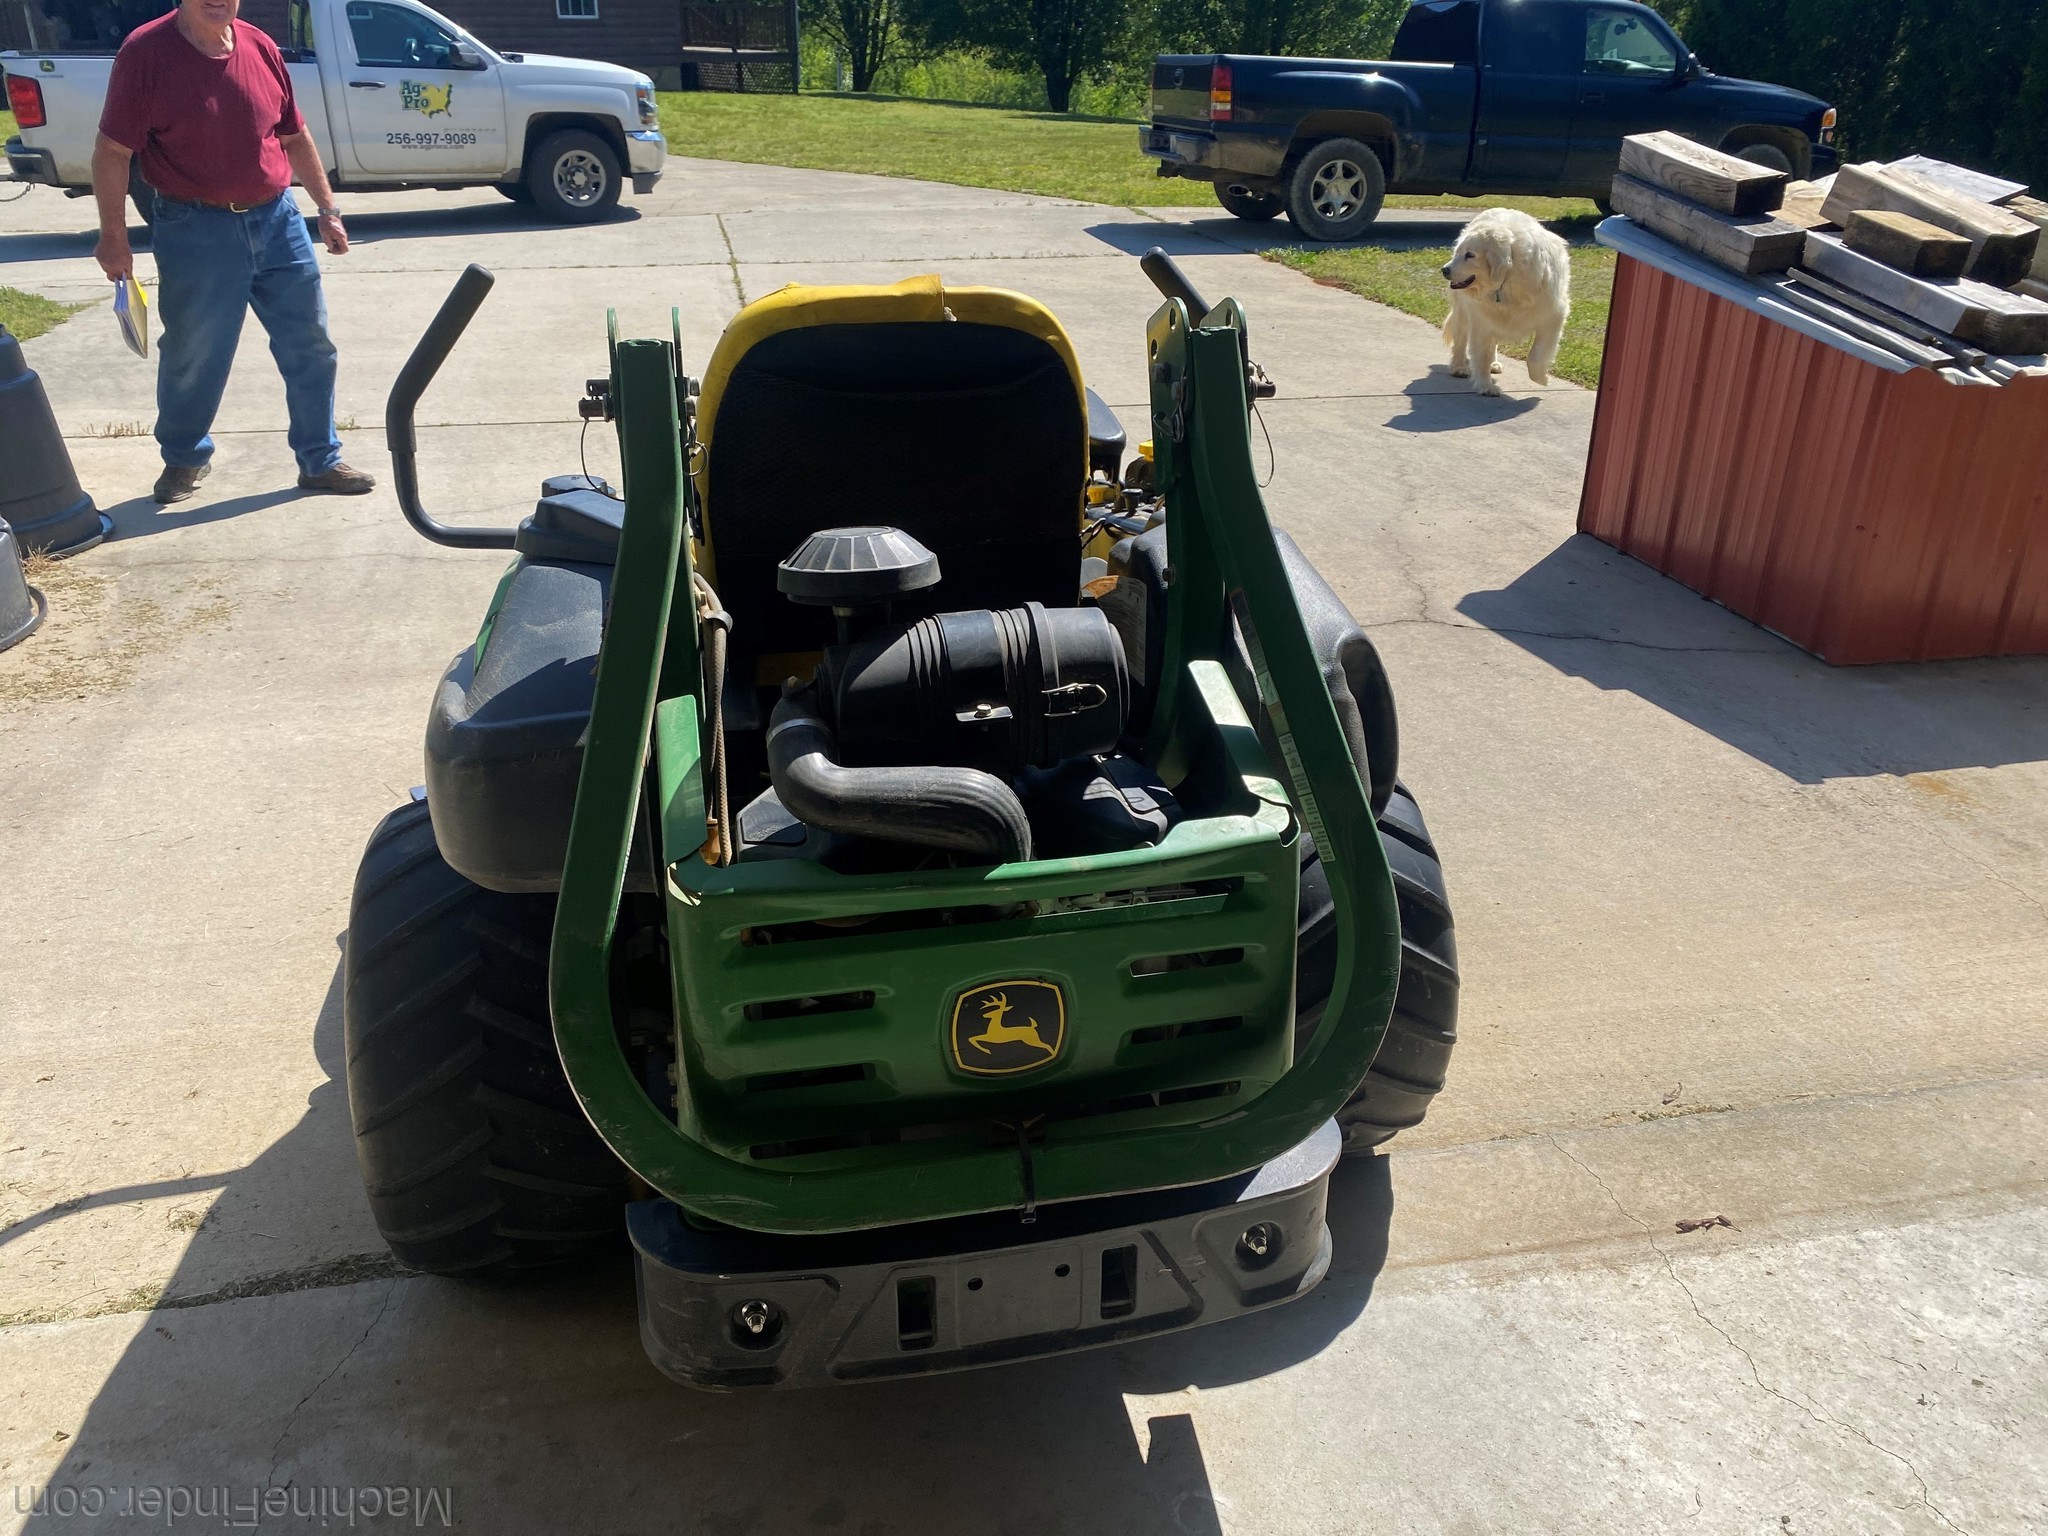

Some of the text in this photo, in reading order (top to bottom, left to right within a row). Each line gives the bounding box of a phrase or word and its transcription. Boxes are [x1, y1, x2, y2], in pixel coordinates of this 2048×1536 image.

[401, 81, 427, 97] Ag-
[403, 95, 430, 109] Pro
[386, 133, 476, 145] 256-997-9089
